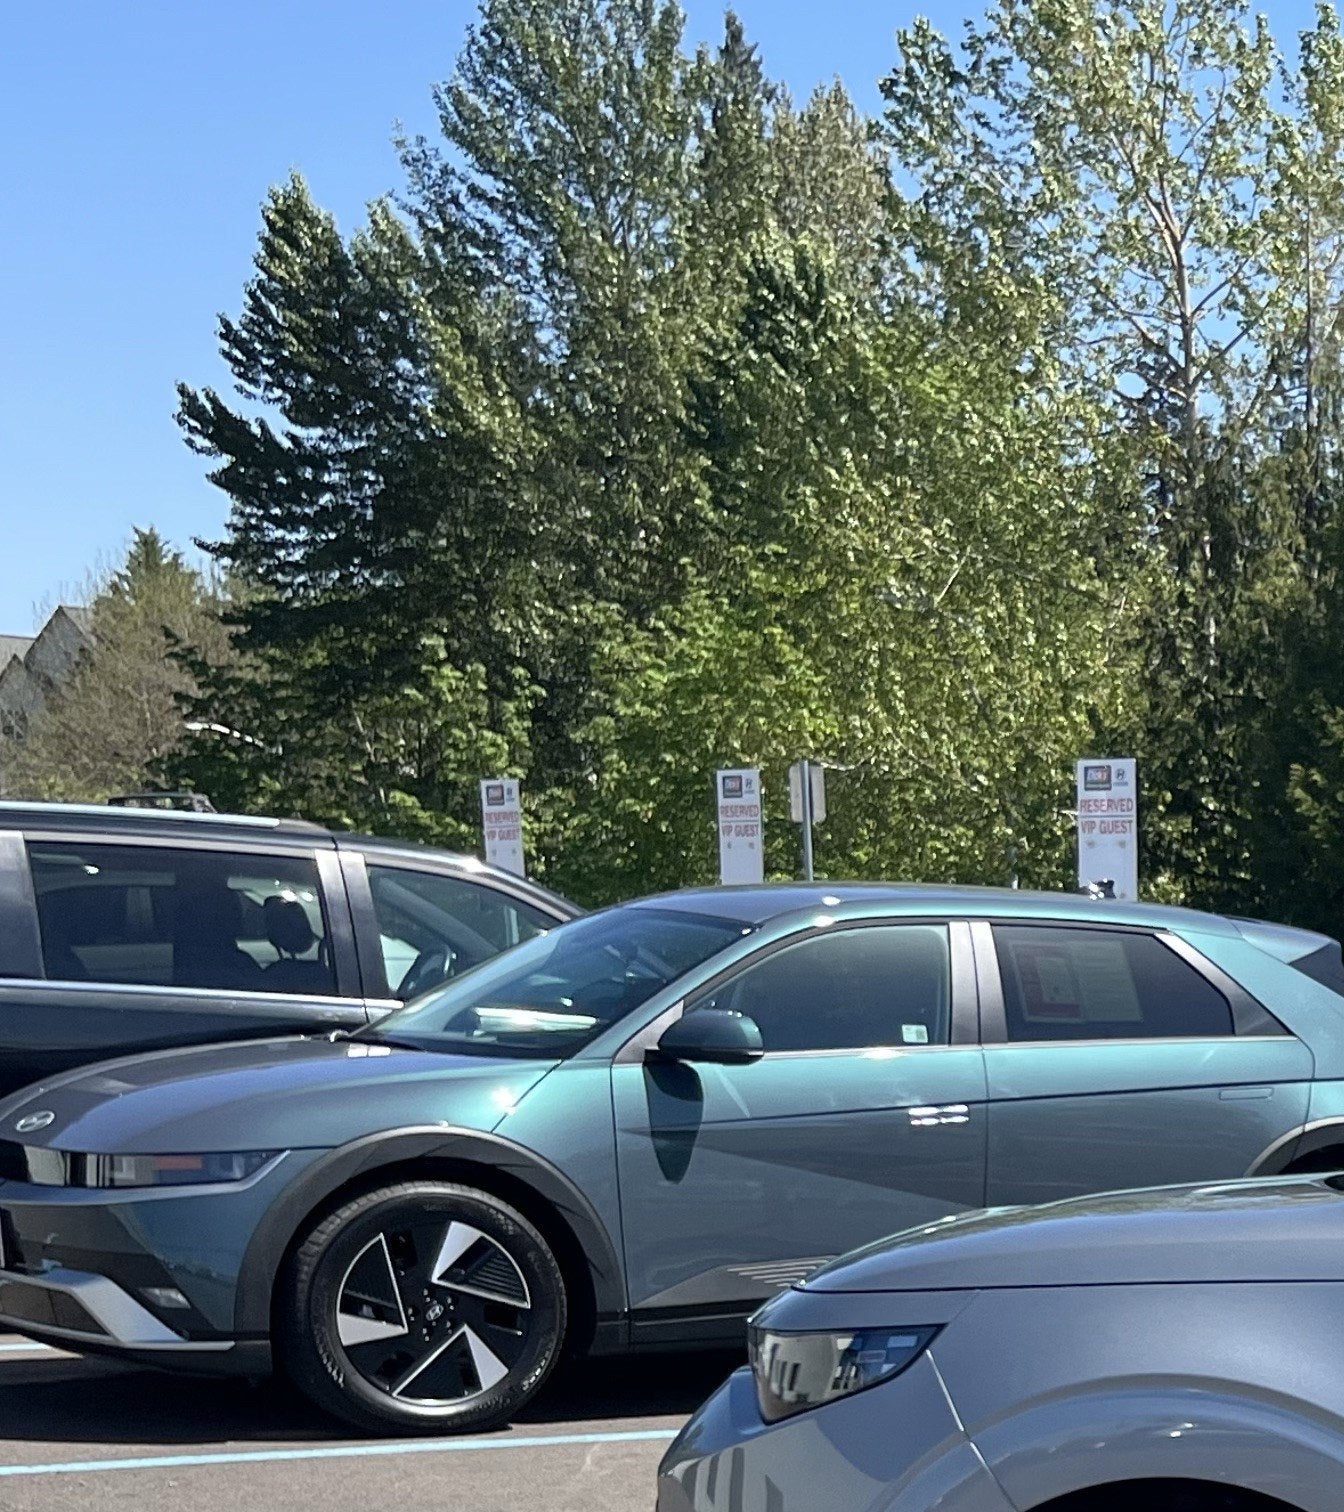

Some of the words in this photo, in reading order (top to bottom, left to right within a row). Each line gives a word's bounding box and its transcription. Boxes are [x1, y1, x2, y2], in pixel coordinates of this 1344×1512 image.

[1080, 798, 1134, 814] RESERVED
[1081, 820, 1097, 834] VIP
[1100, 820, 1134, 834] GUEST
